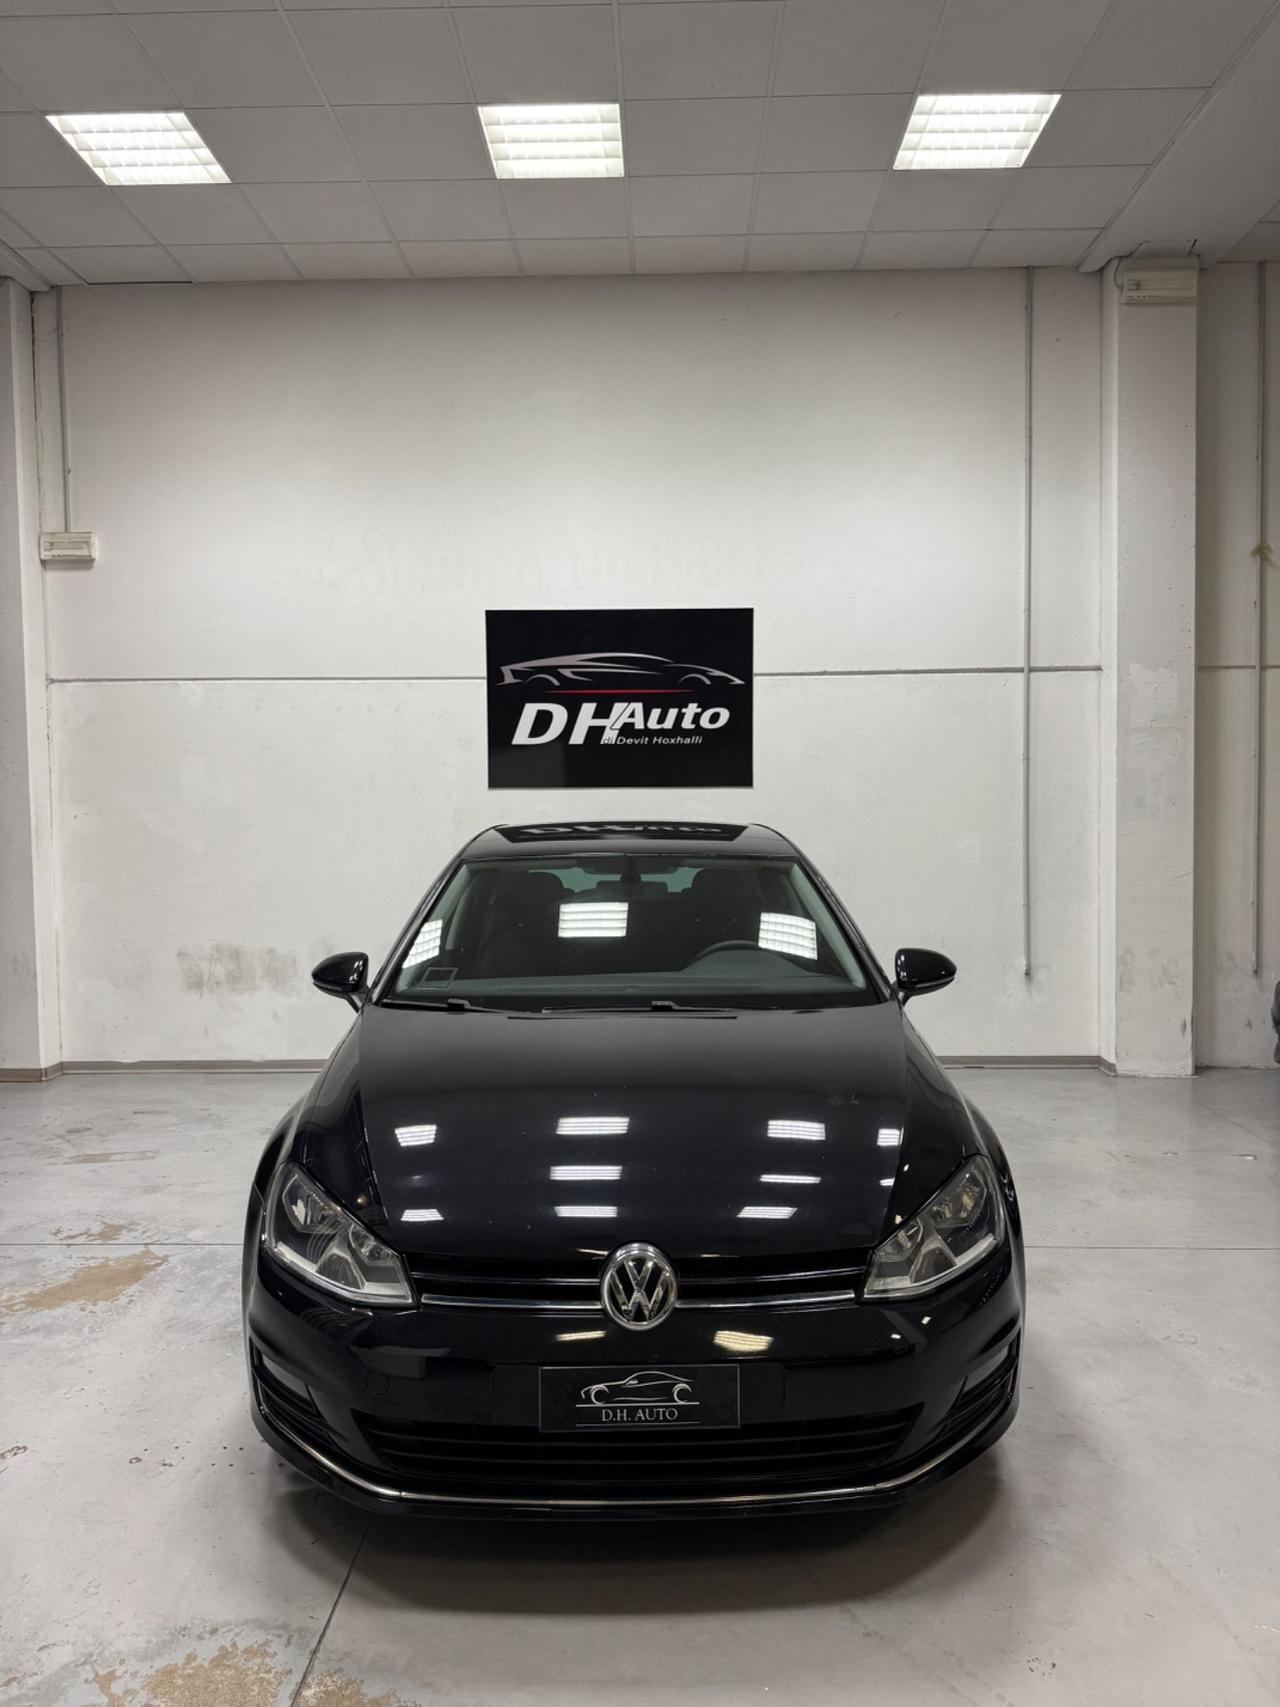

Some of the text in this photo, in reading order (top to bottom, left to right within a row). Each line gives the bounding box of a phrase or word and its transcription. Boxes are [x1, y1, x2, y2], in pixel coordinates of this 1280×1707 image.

[617, 736, 649, 745] Devit
[652, 735, 703, 745] Hoxhalli
[601, 1407, 678, 1422] D.H. AUTO
